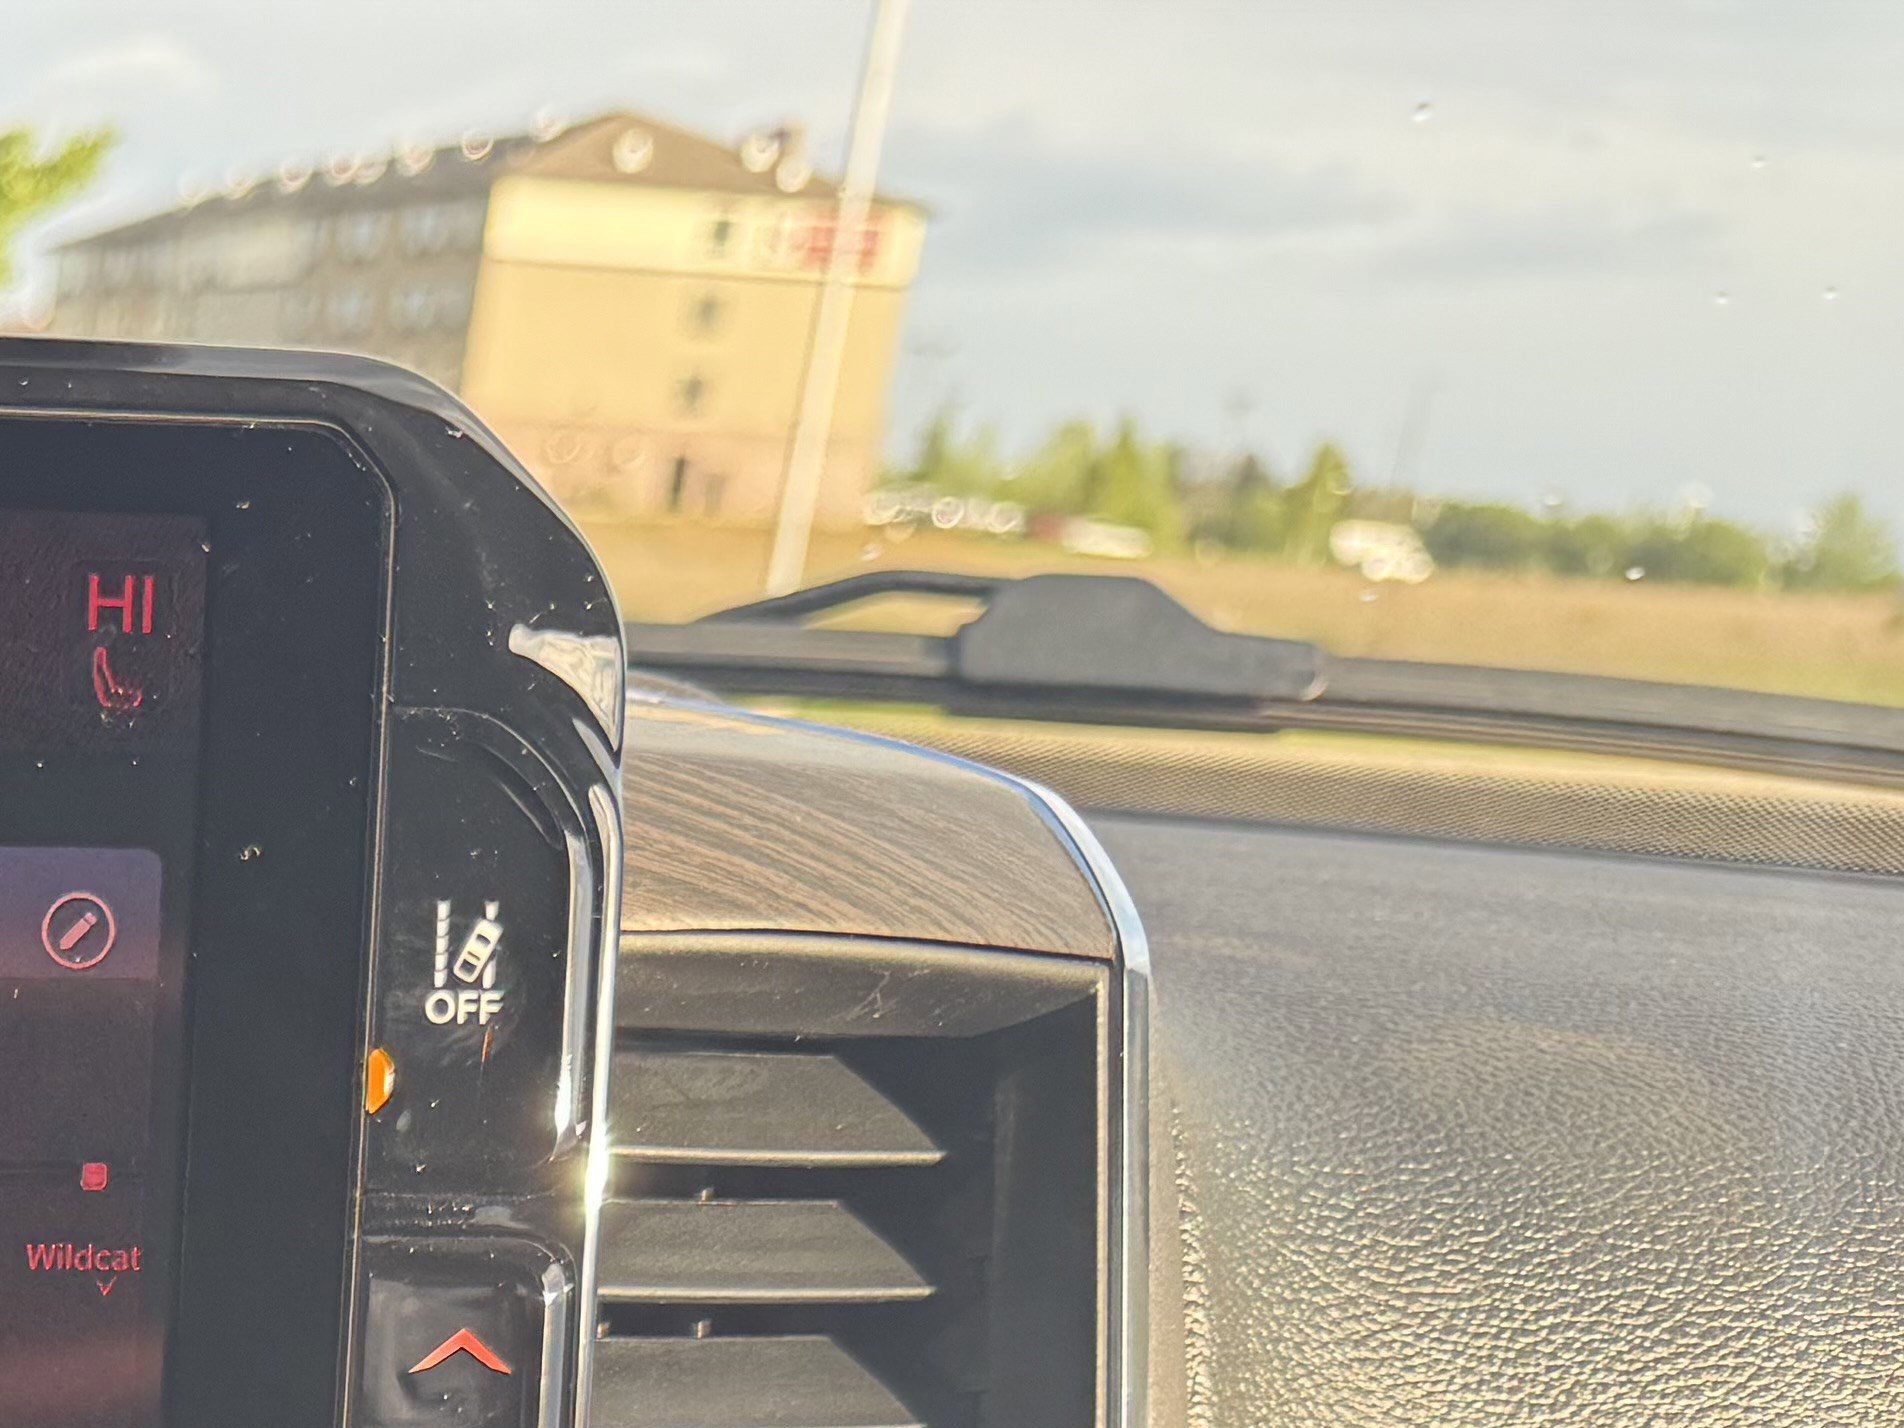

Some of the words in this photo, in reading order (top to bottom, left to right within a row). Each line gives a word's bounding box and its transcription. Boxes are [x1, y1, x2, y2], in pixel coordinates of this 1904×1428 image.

[86, 574, 154, 635] HI
[424, 989, 504, 1026] OFF
[26, 1241, 141, 1274] Wildcat
